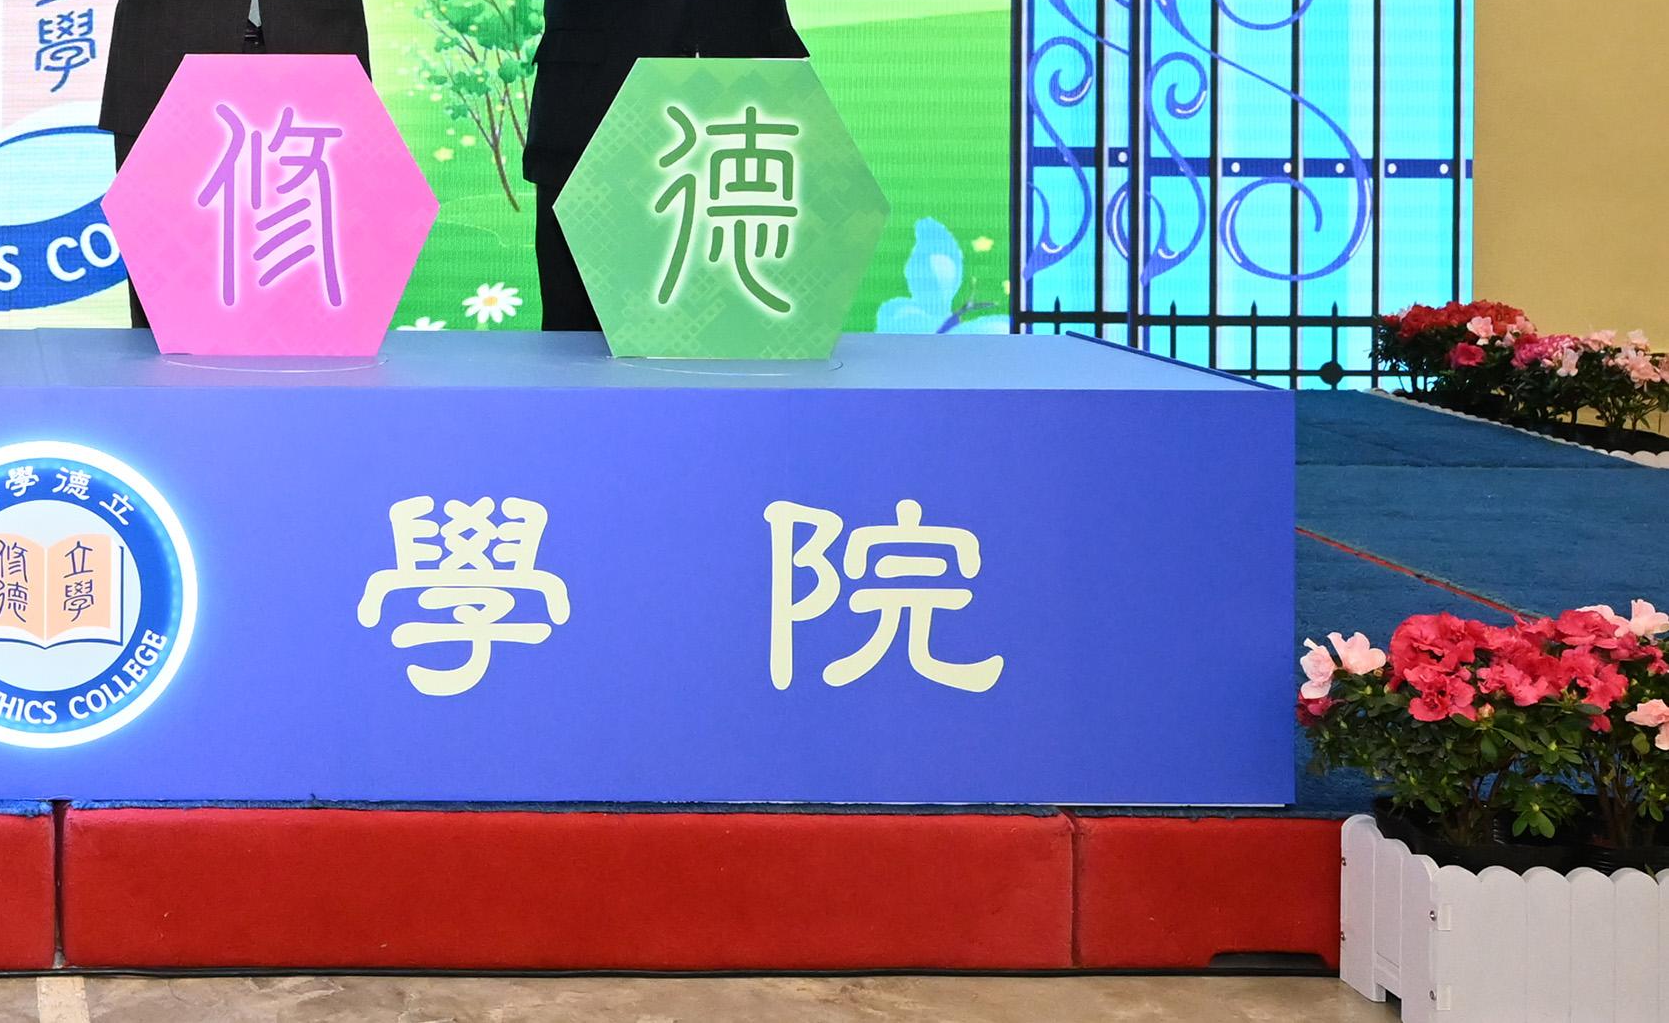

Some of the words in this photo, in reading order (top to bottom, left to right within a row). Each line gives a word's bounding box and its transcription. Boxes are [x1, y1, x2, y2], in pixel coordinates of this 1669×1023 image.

[197, 103, 344, 308] 修
[654, 105, 800, 313] 德
[68, 629, 168, 721] COLLEGE
